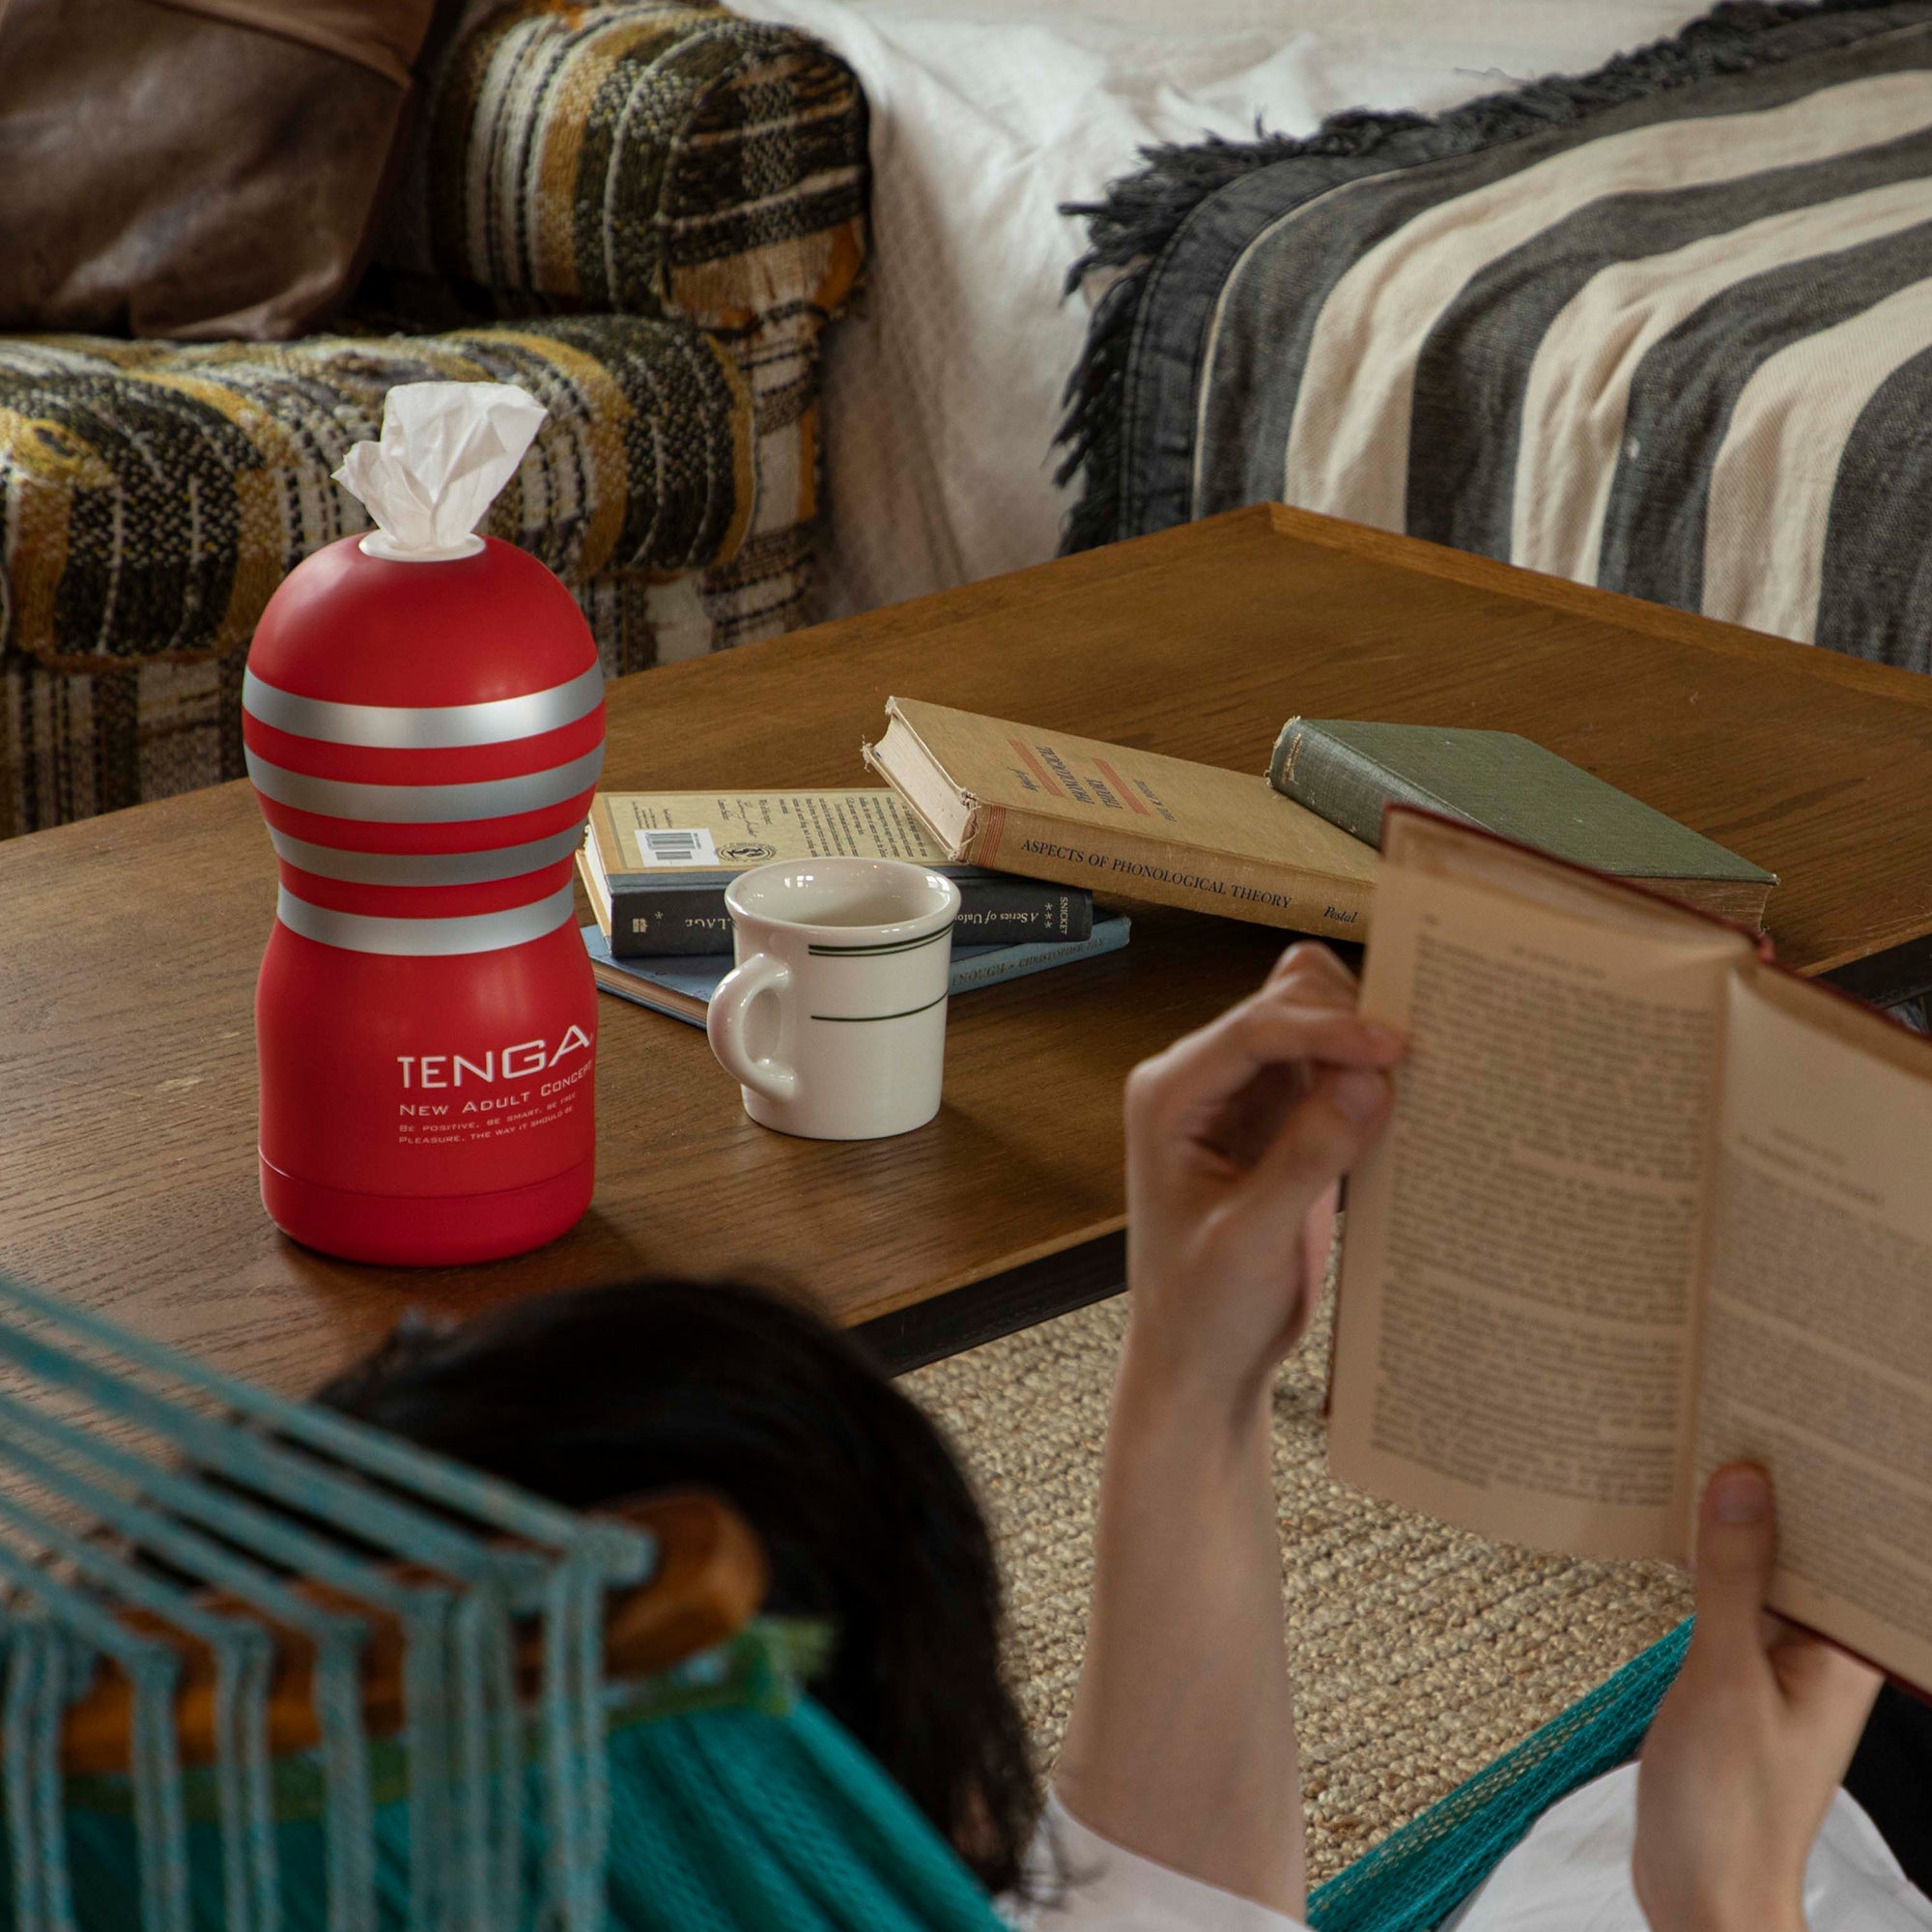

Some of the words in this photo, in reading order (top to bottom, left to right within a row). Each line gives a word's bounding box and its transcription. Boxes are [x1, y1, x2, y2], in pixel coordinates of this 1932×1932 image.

[1021, 838, 1084, 863] ASPECTS
[1088, 853, 1109, 867] OF
[1112, 858, 1226, 895] PHONOLOGICAL
[1231, 885, 1293, 909] THEORY
[984, 910, 997, 924] of
[1000, 912, 1029, 923] Series
[1031, 912, 1038, 923] A
[1060, 896, 1068, 935] SNICKET
[1323, 905, 1358, 923] Postal
[397, 1024, 589, 1089] TENGA
[399, 1104, 449, 1116] NEW
[462, 1092, 530, 1114] ADULT
[541, 1059, 593, 1096] CONCEPT
